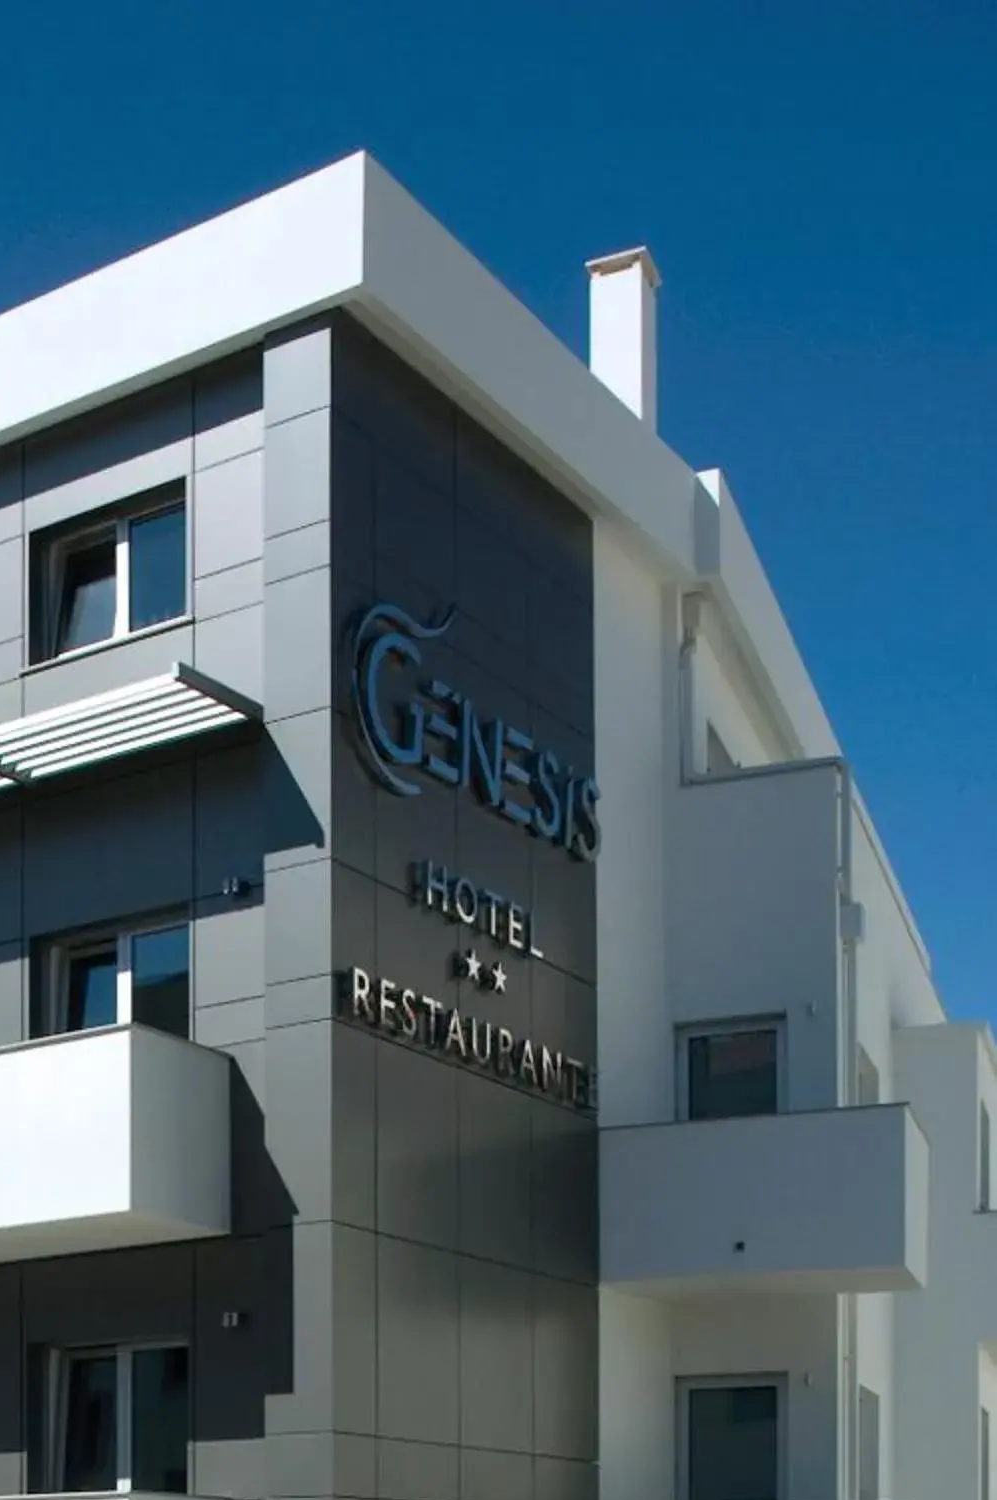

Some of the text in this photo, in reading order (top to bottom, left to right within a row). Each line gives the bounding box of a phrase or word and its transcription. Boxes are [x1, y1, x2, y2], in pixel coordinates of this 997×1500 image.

[352, 604, 601, 863] GENESIS
[425, 860, 544, 960] HOTEL
[353, 966, 600, 1107] RESTAURANTE
